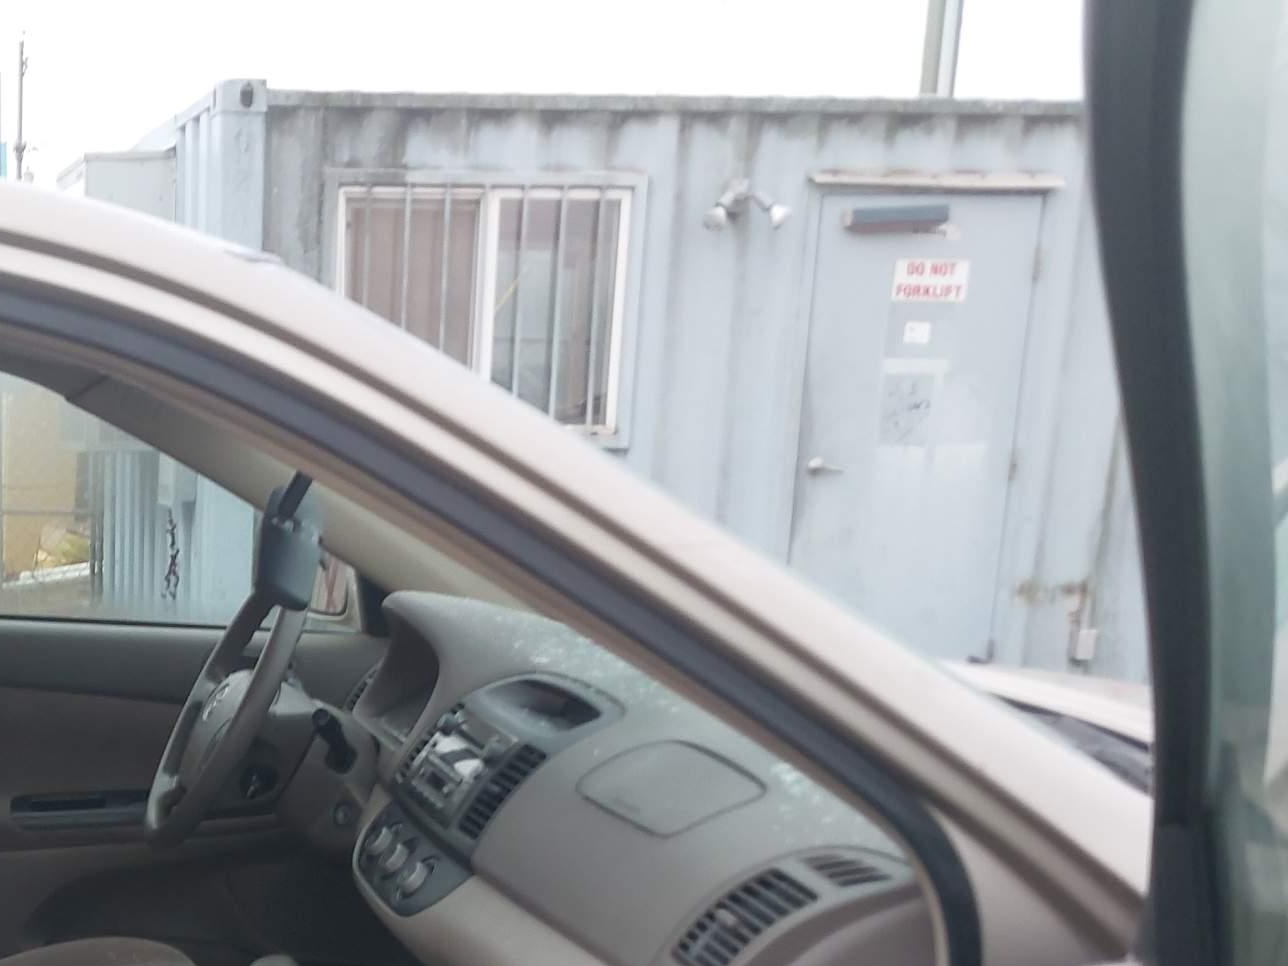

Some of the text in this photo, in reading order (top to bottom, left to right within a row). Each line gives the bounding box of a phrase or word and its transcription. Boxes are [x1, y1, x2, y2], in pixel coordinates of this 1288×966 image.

[906, 261, 956, 276] DO NOT
[895, 283, 962, 298] FORKLIFT
